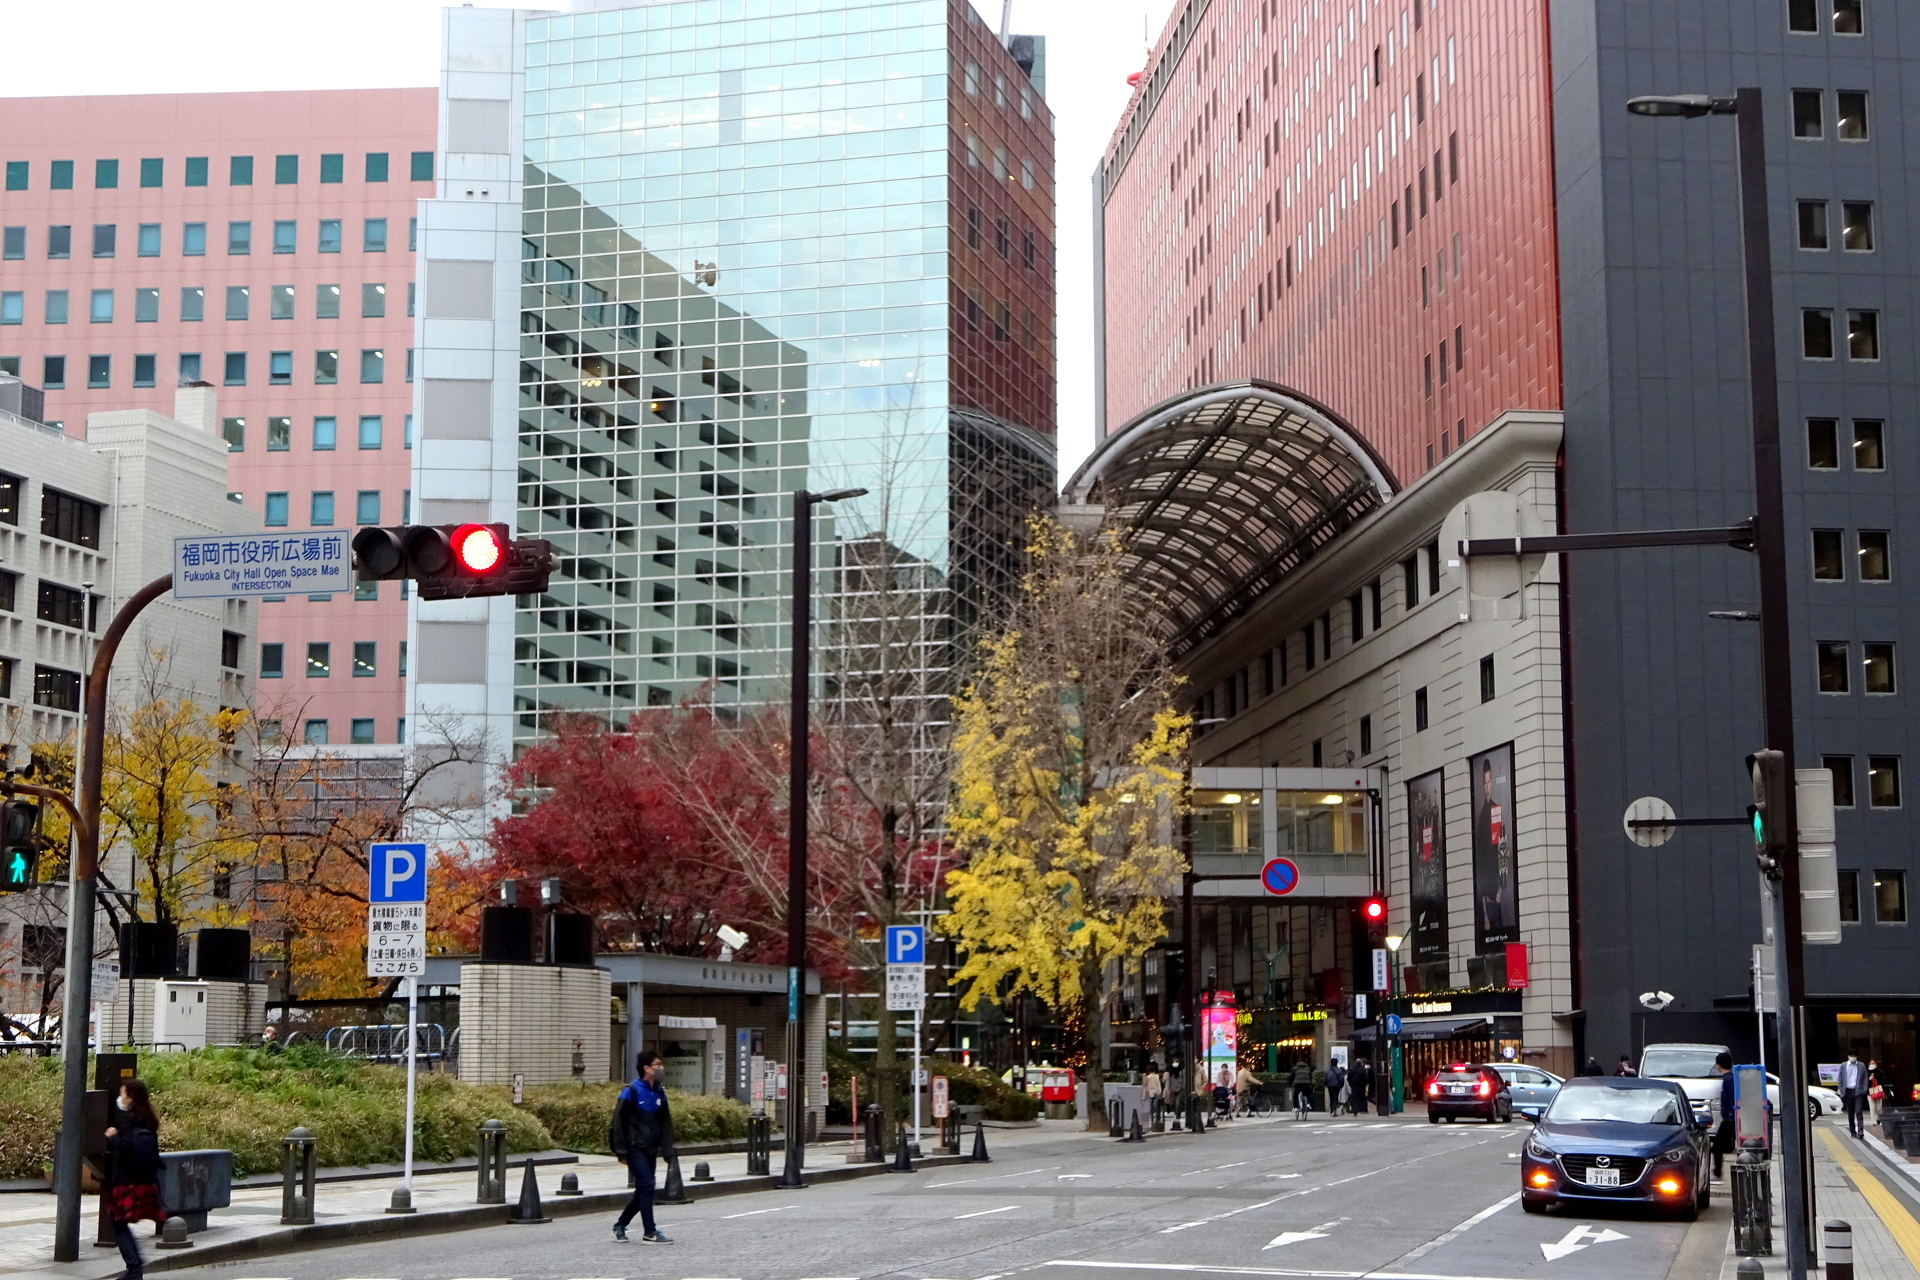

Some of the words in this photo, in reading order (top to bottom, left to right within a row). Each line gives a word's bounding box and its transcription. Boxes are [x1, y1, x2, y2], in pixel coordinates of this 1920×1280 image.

[182, 536, 342, 567] 福岡市役所広場前
[184, 570, 220, 582] Fukuoka
[223, 568, 240, 582] City
[244, 567, 261, 579] Hall
[264, 566, 287, 581] Open
[290, 565, 318, 579] Space
[321, 564, 340, 576] Mae
[231, 580, 292, 591] INTERSECTION
[385, 850, 417, 898] P
[372, 920, 419, 932] 貨物に限る
[896, 929, 918, 961] P
[374, 962, 419, 973] ここから
